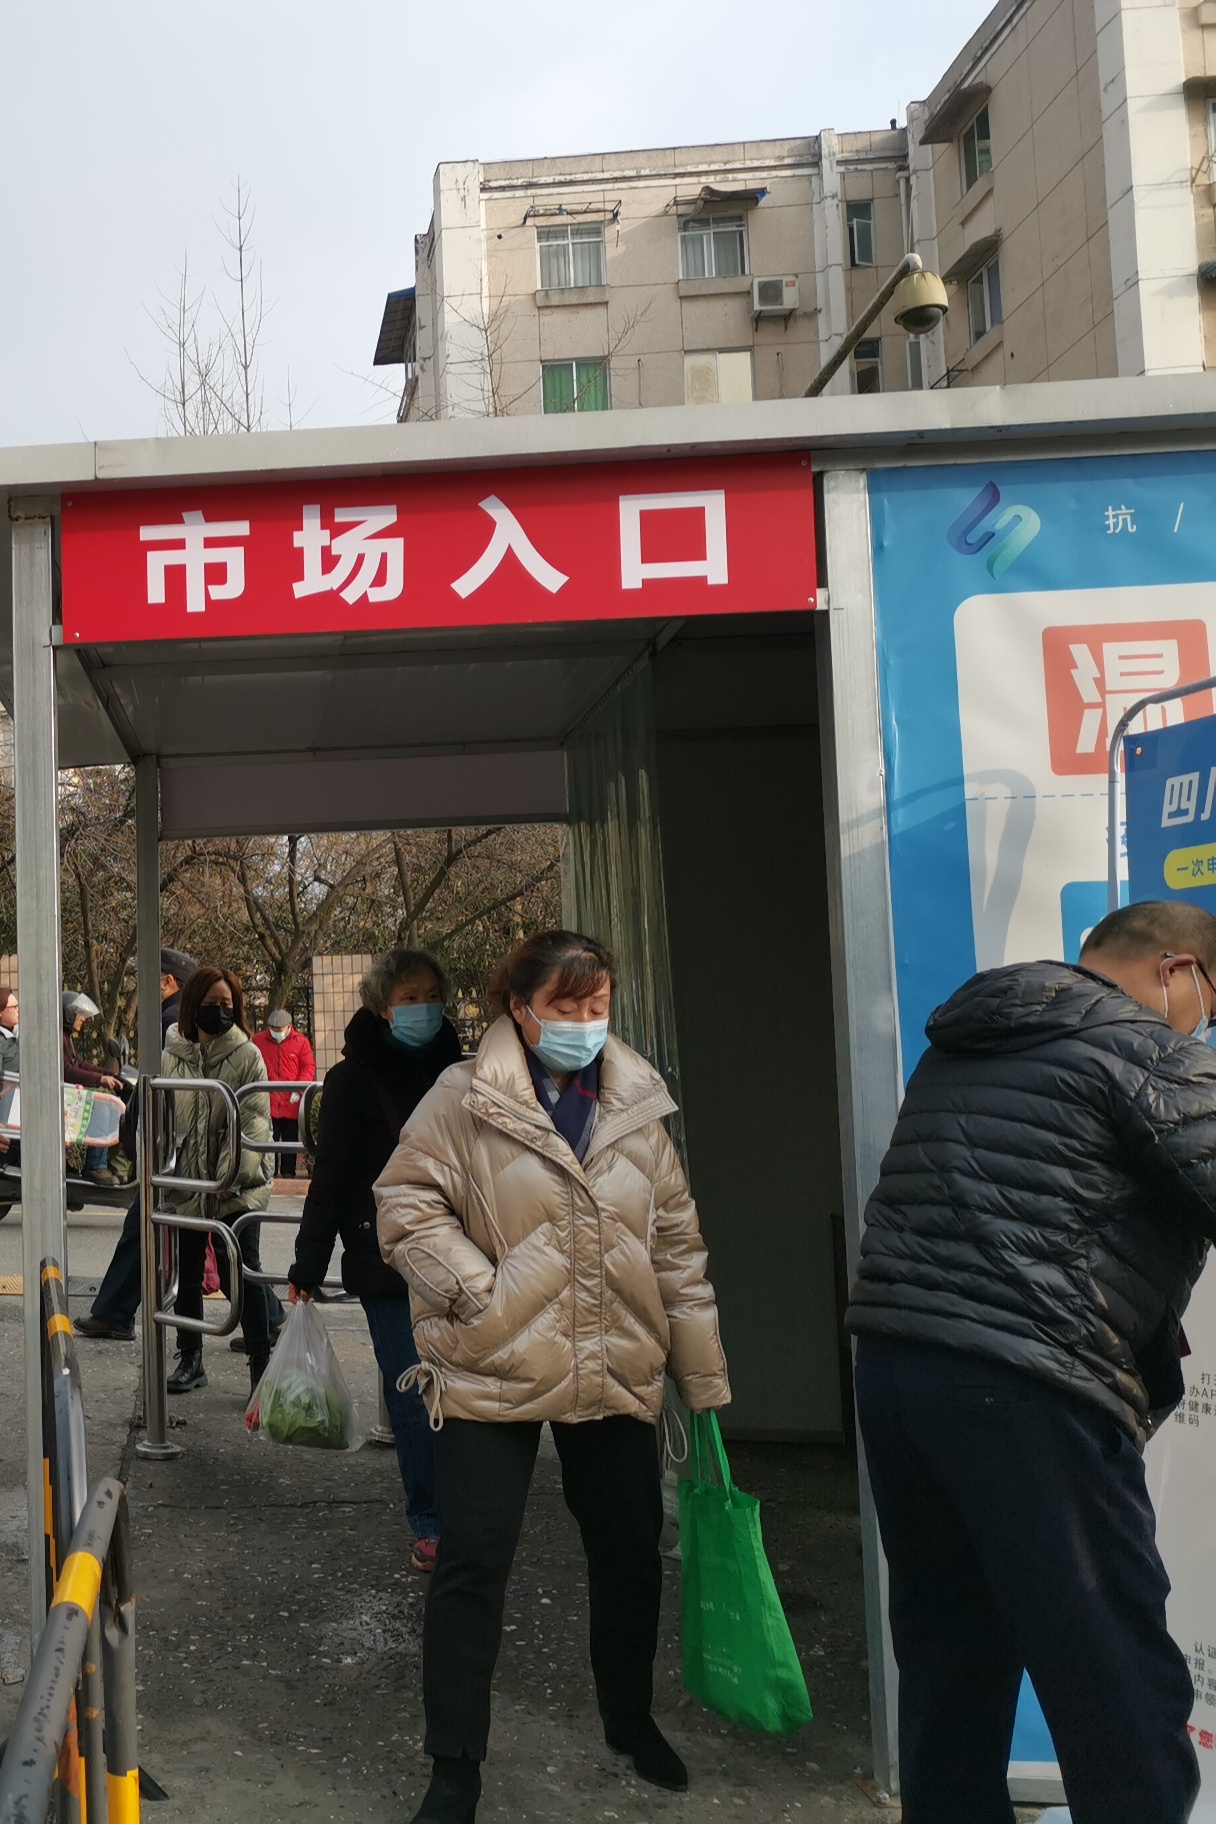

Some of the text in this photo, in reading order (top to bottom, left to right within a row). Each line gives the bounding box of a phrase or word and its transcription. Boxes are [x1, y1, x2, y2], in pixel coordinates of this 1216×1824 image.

[1104, 505, 1137, 534] 抗
[139, 489, 728, 612] 市场入口
[1069, 638, 1183, 754] 温
[1201, 1371, 1216, 1386] 打
[1175, 1411, 1199, 1427] 维码
